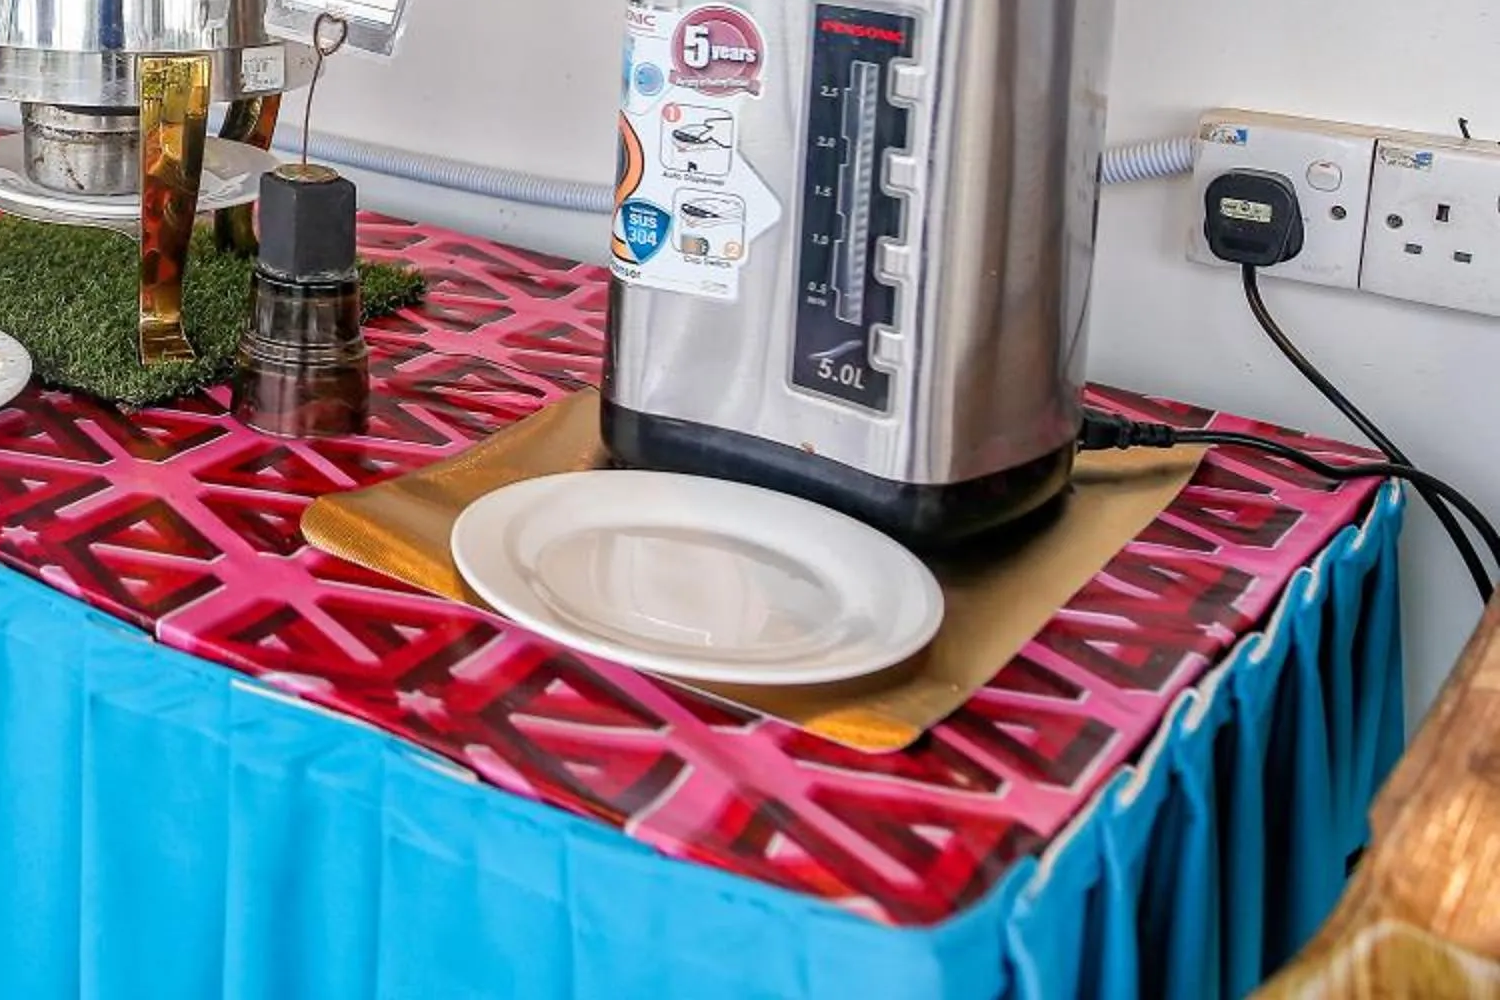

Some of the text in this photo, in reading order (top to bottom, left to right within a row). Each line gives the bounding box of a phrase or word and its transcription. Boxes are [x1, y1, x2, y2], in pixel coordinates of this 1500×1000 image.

[683, 24, 710, 69] 5
[820, 85, 839, 98] 2.5
[816, 136, 836, 148] 2.0
[814, 185, 833, 198] 1.5
[628, 226, 657, 247] 304
[812, 233, 829, 246] 1.0
[807, 280, 827, 295] 0.5
[818, 358, 867, 391] 5.0L
